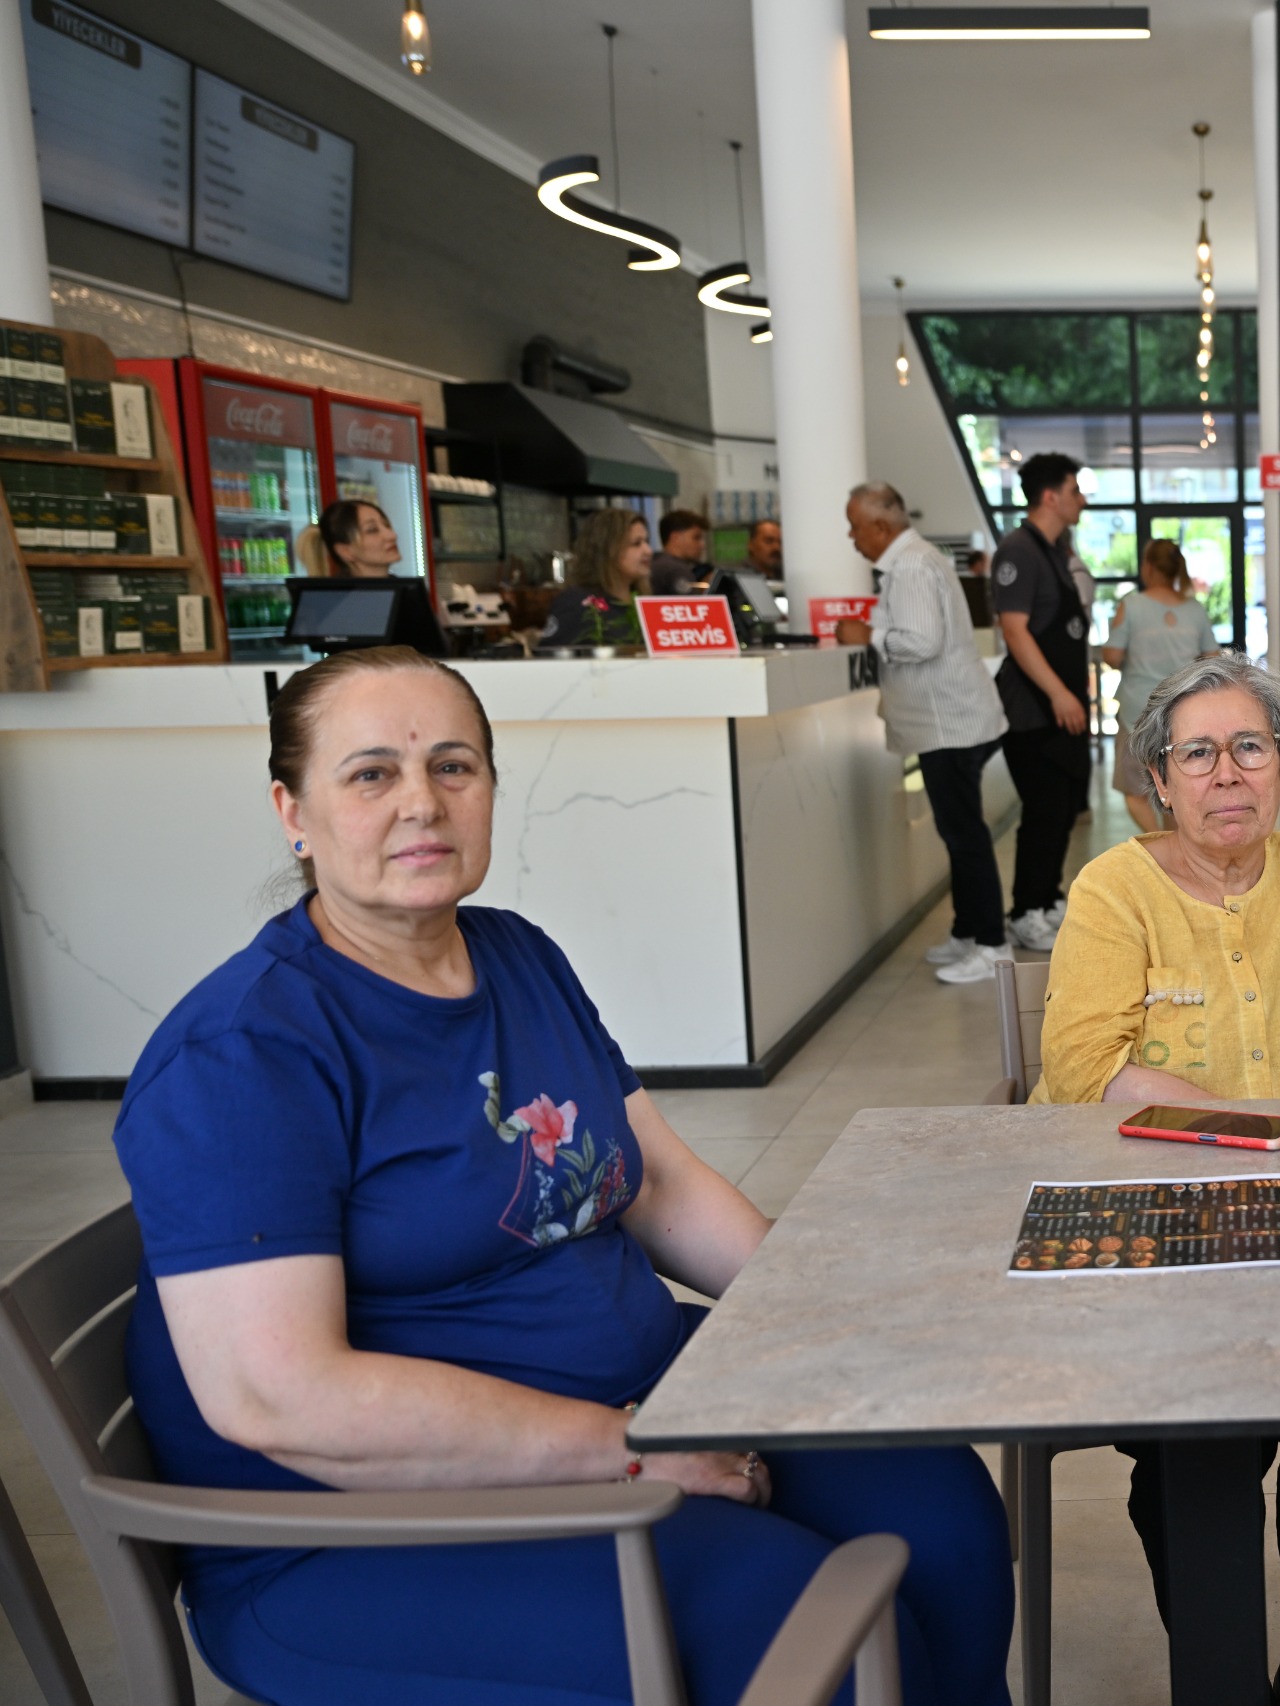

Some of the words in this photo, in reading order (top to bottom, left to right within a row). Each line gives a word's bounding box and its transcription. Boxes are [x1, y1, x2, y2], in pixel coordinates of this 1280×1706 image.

[660, 604, 709, 622] SELF
[824, 601, 866, 616] SELF
[656, 623, 728, 647] SERVİS
